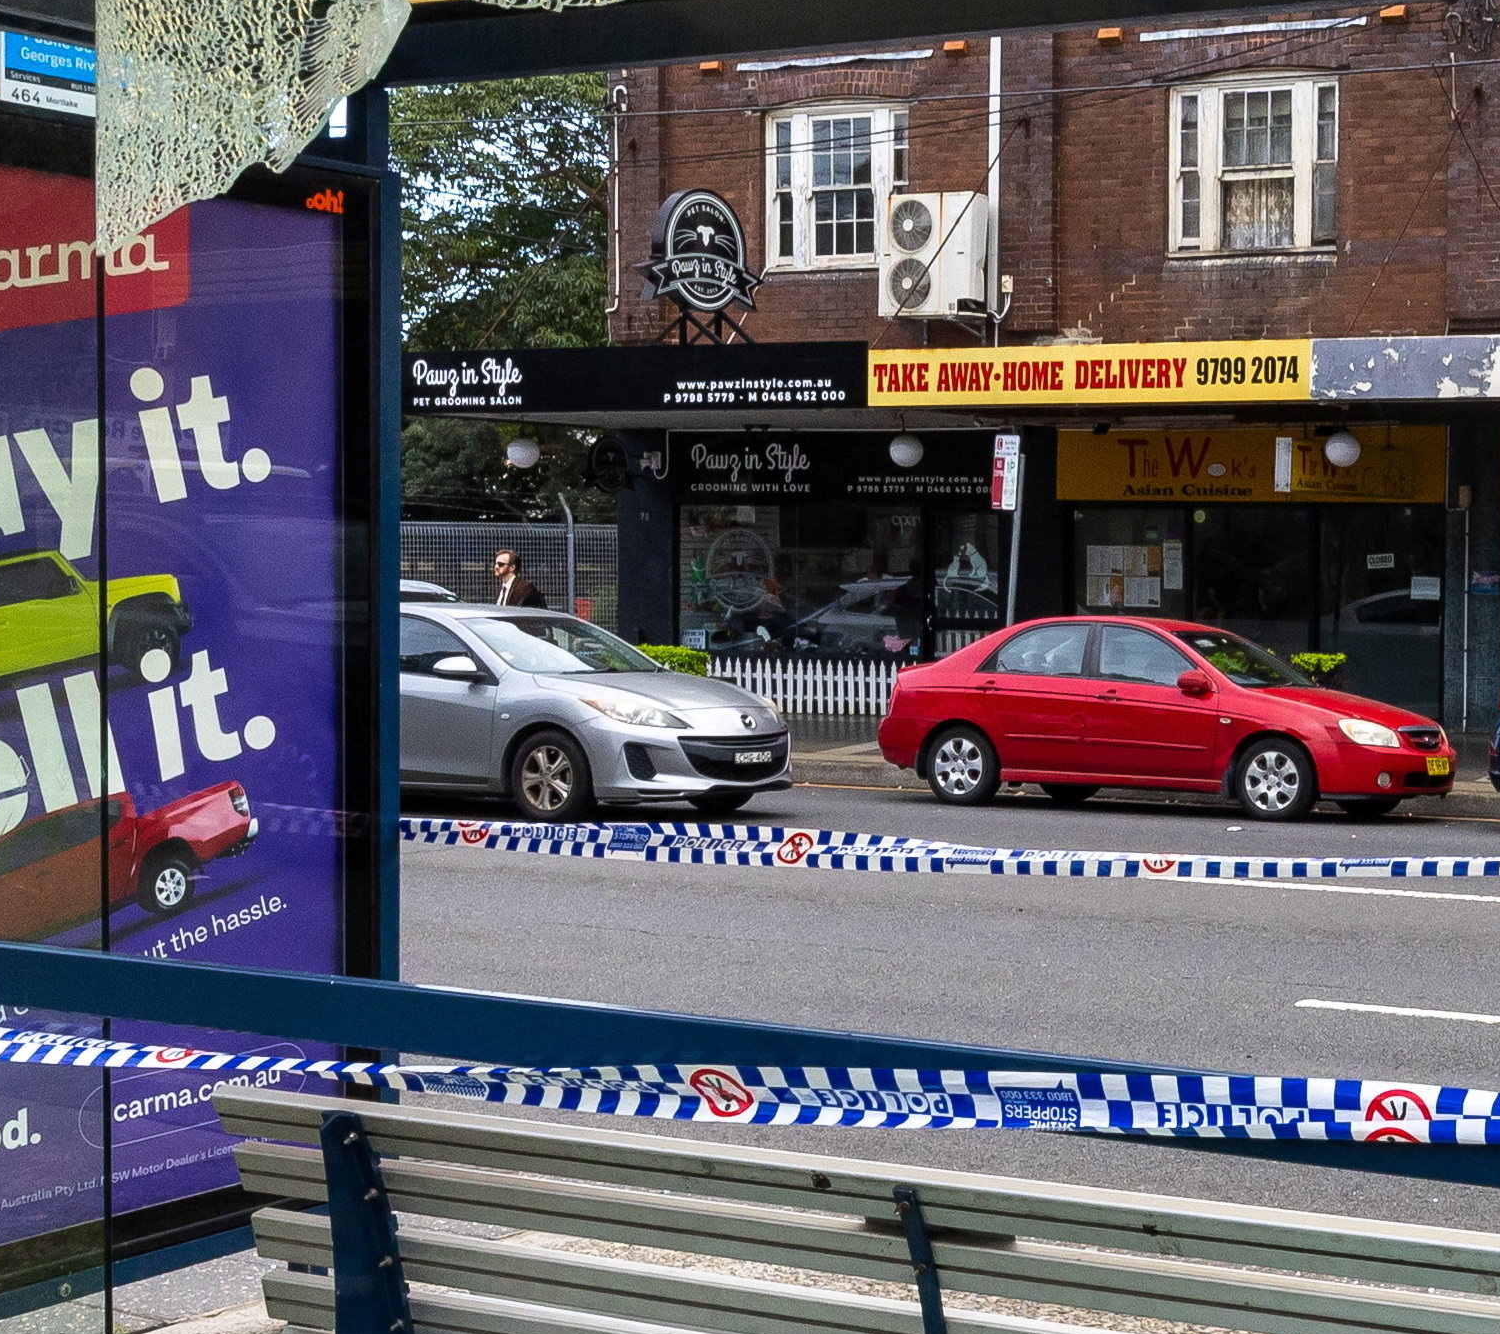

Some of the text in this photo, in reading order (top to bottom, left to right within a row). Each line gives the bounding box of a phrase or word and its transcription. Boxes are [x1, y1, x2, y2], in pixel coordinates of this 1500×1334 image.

[20, 46, 73, 68] Georges
[11, 71, 41, 83] Services
[11, 87, 79, 109] 464 Mortlake
[671, 257, 737, 287] Pawz in Style
[412, 357, 523, 397] Pawz in Style
[676, 377, 832, 393] www.pawzinstyle.com.au
[873, 355, 1300, 393] TAKE AWAY HOME DELIVERY 9799 2074
[413, 395, 523, 407] PET GROOMING SALON
[663, 391, 846, 404] P 9798 5779 M 0468 452 000
[130, 367, 272, 504] it.
[690, 442, 811, 481] Pawz in Style
[1117, 438, 1160, 480] The
[690, 483, 811, 493] GROOMING WITH LOVE
[1122, 483, 1253, 497] Asian Cuisine
[1368, 555, 1393, 566] CLOSED
[140, 649, 276, 783] it.
[672, 837, 749, 852] POLICE
[170, 898, 288, 951] the hassle.
[818, 1089, 955, 1119] POLICE
[1004, 1103, 1078, 1121] STOPPERS
[0, 1188, 52, 1213] Australia
[54, 1182, 74, 1201] Pty
[76, 1176, 99, 1195] Ltd.
[131, 1160, 165, 1180] Motor
[166, 1148, 207, 1172] Dealer's
